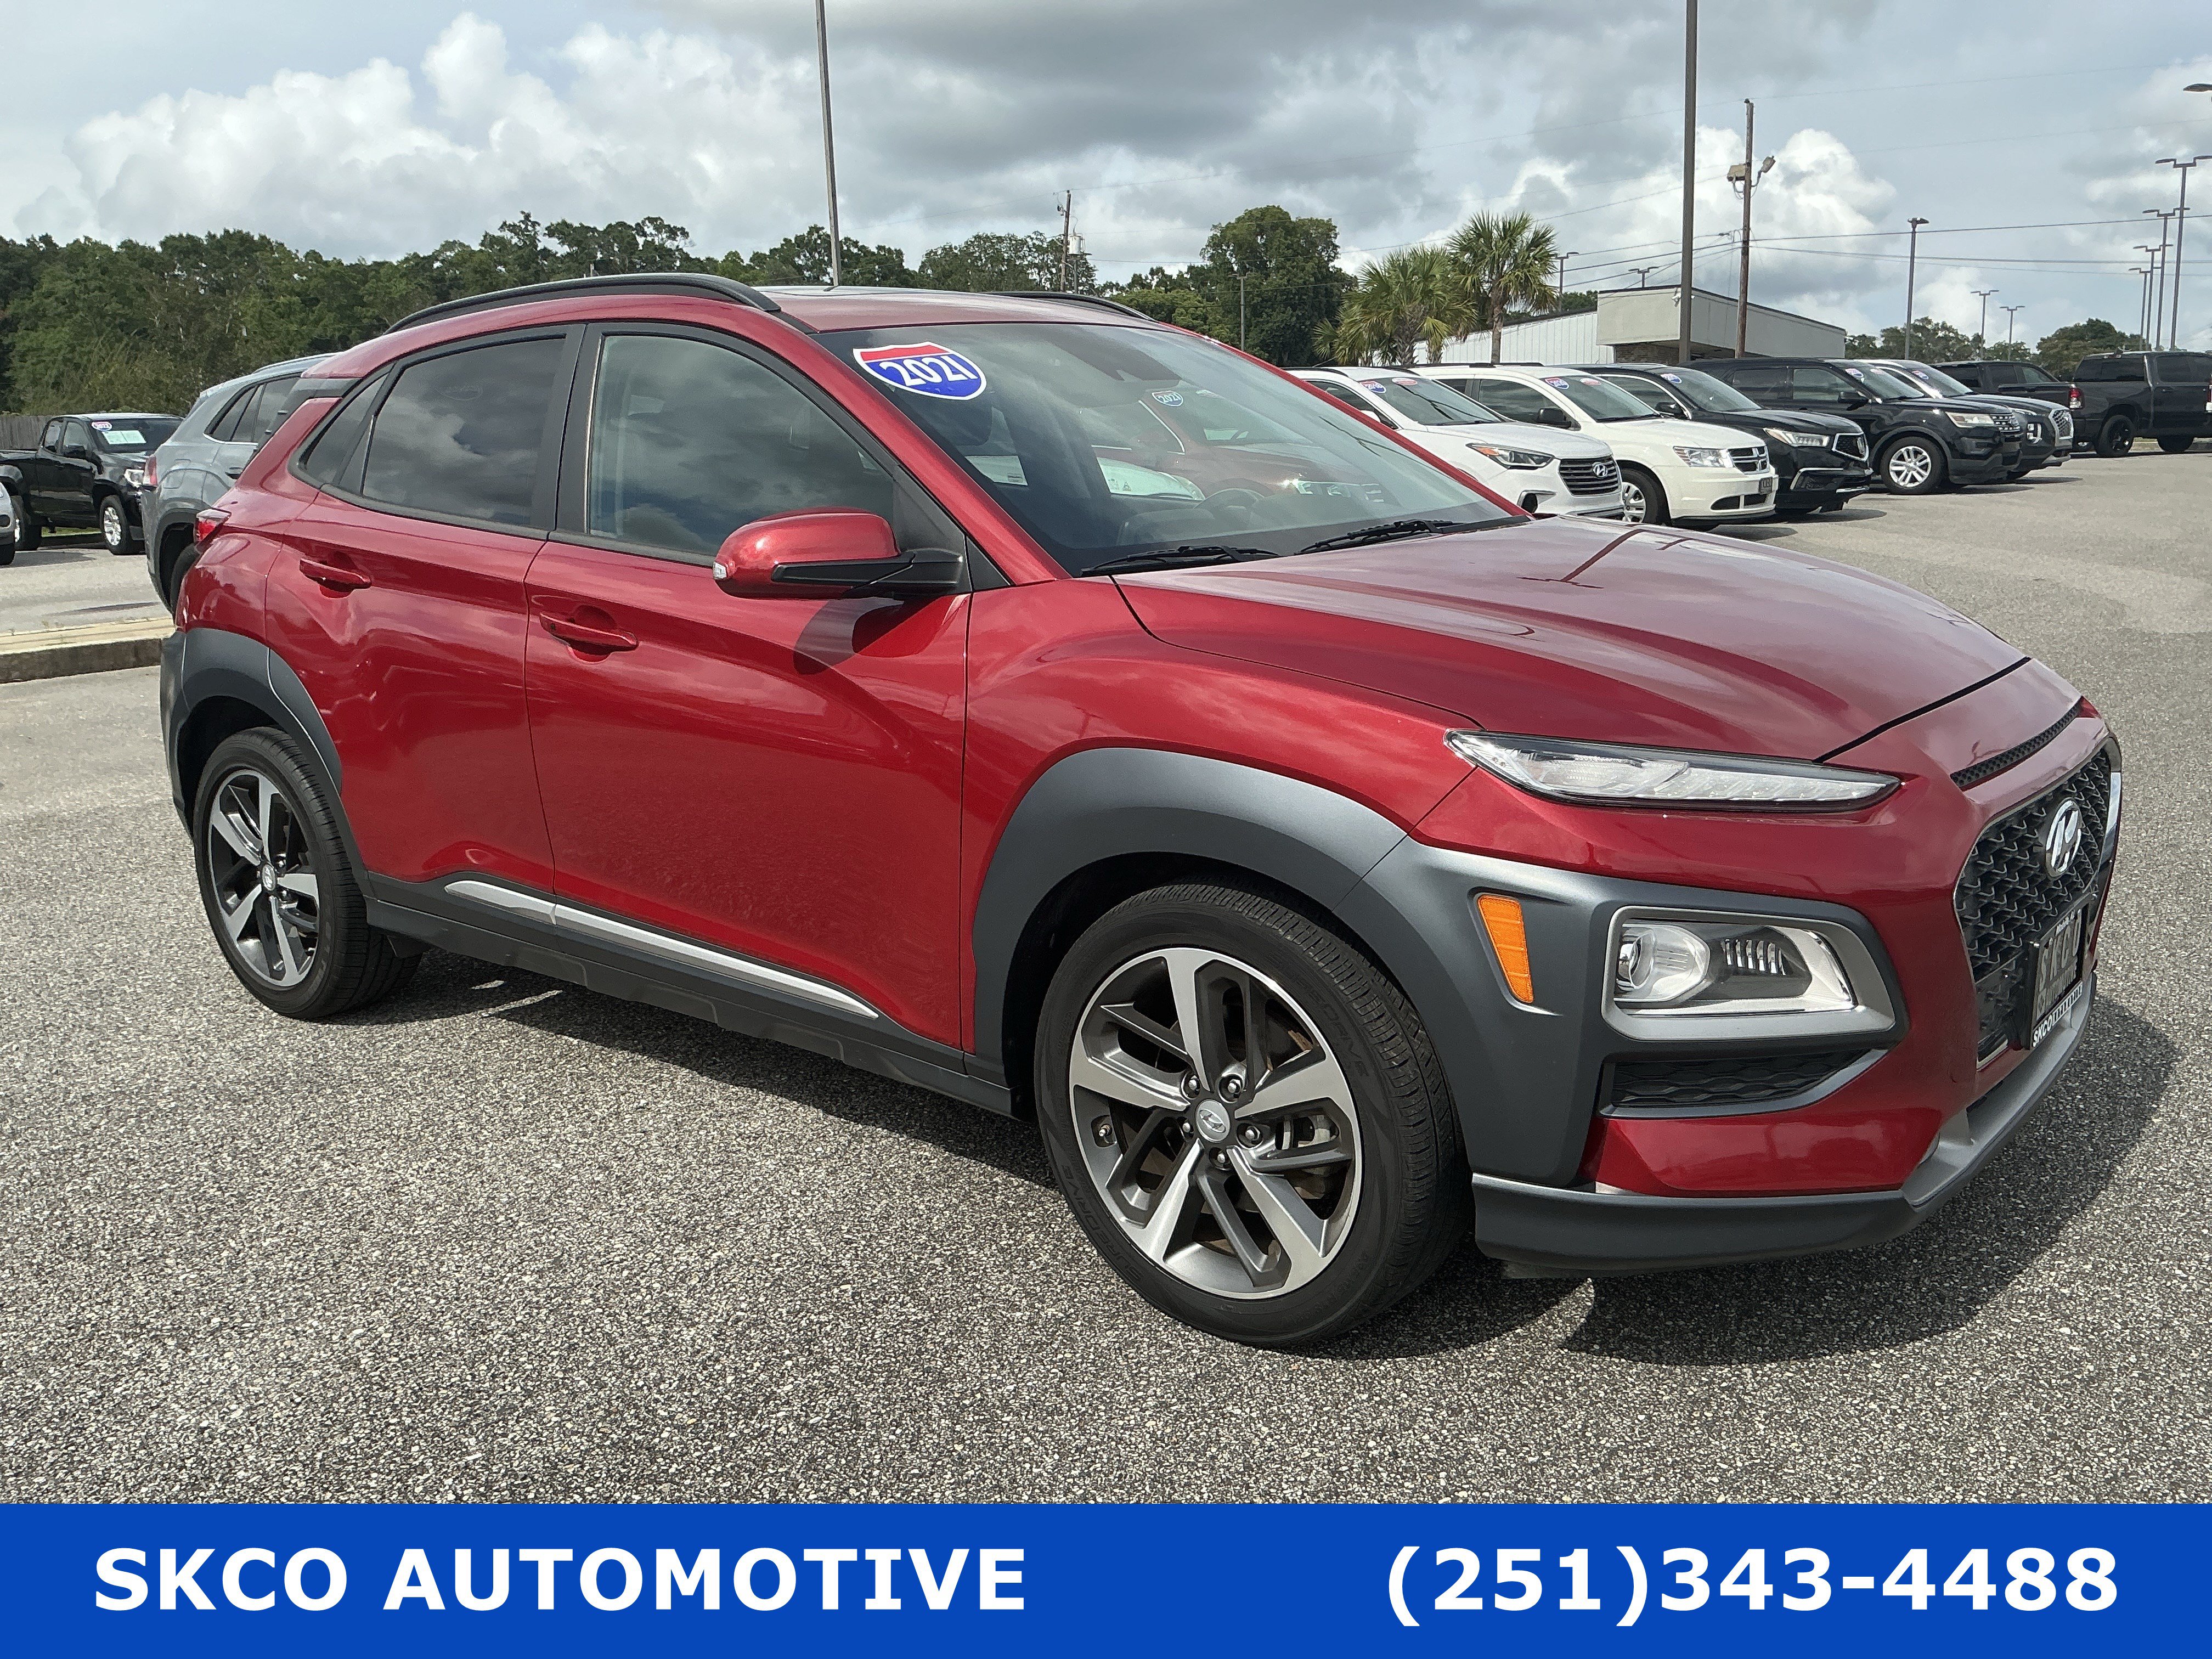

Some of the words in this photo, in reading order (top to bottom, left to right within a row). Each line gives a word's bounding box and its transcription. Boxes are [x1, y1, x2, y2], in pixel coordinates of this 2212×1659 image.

[879, 355, 978, 387] 2021
[1158, 393, 1182, 403] 2021
[2039, 908, 2083, 992] SKCO
[2033, 1015, 2052, 1047] SKCO
[1061, 1164, 1144, 1283] SUREDRIVE
